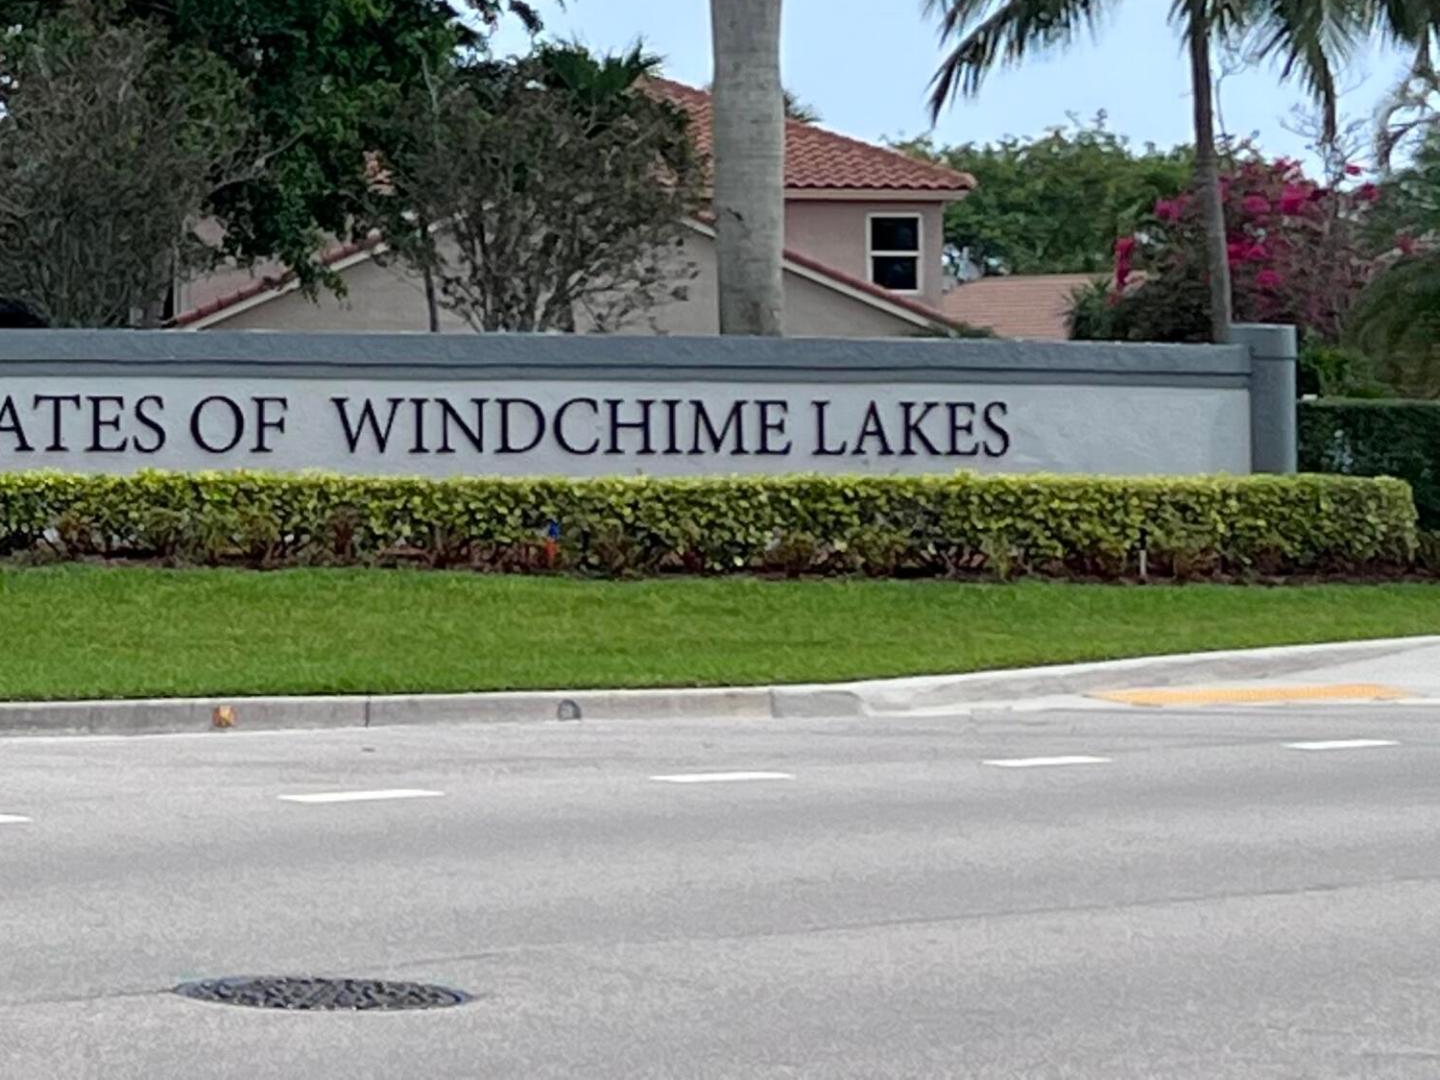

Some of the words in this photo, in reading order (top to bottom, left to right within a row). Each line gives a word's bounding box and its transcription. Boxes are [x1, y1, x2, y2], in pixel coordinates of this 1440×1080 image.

[189, 395, 289, 455] OF
[328, 396, 793, 457] WINDCHIME
[810, 399, 1011, 459] LAKES
